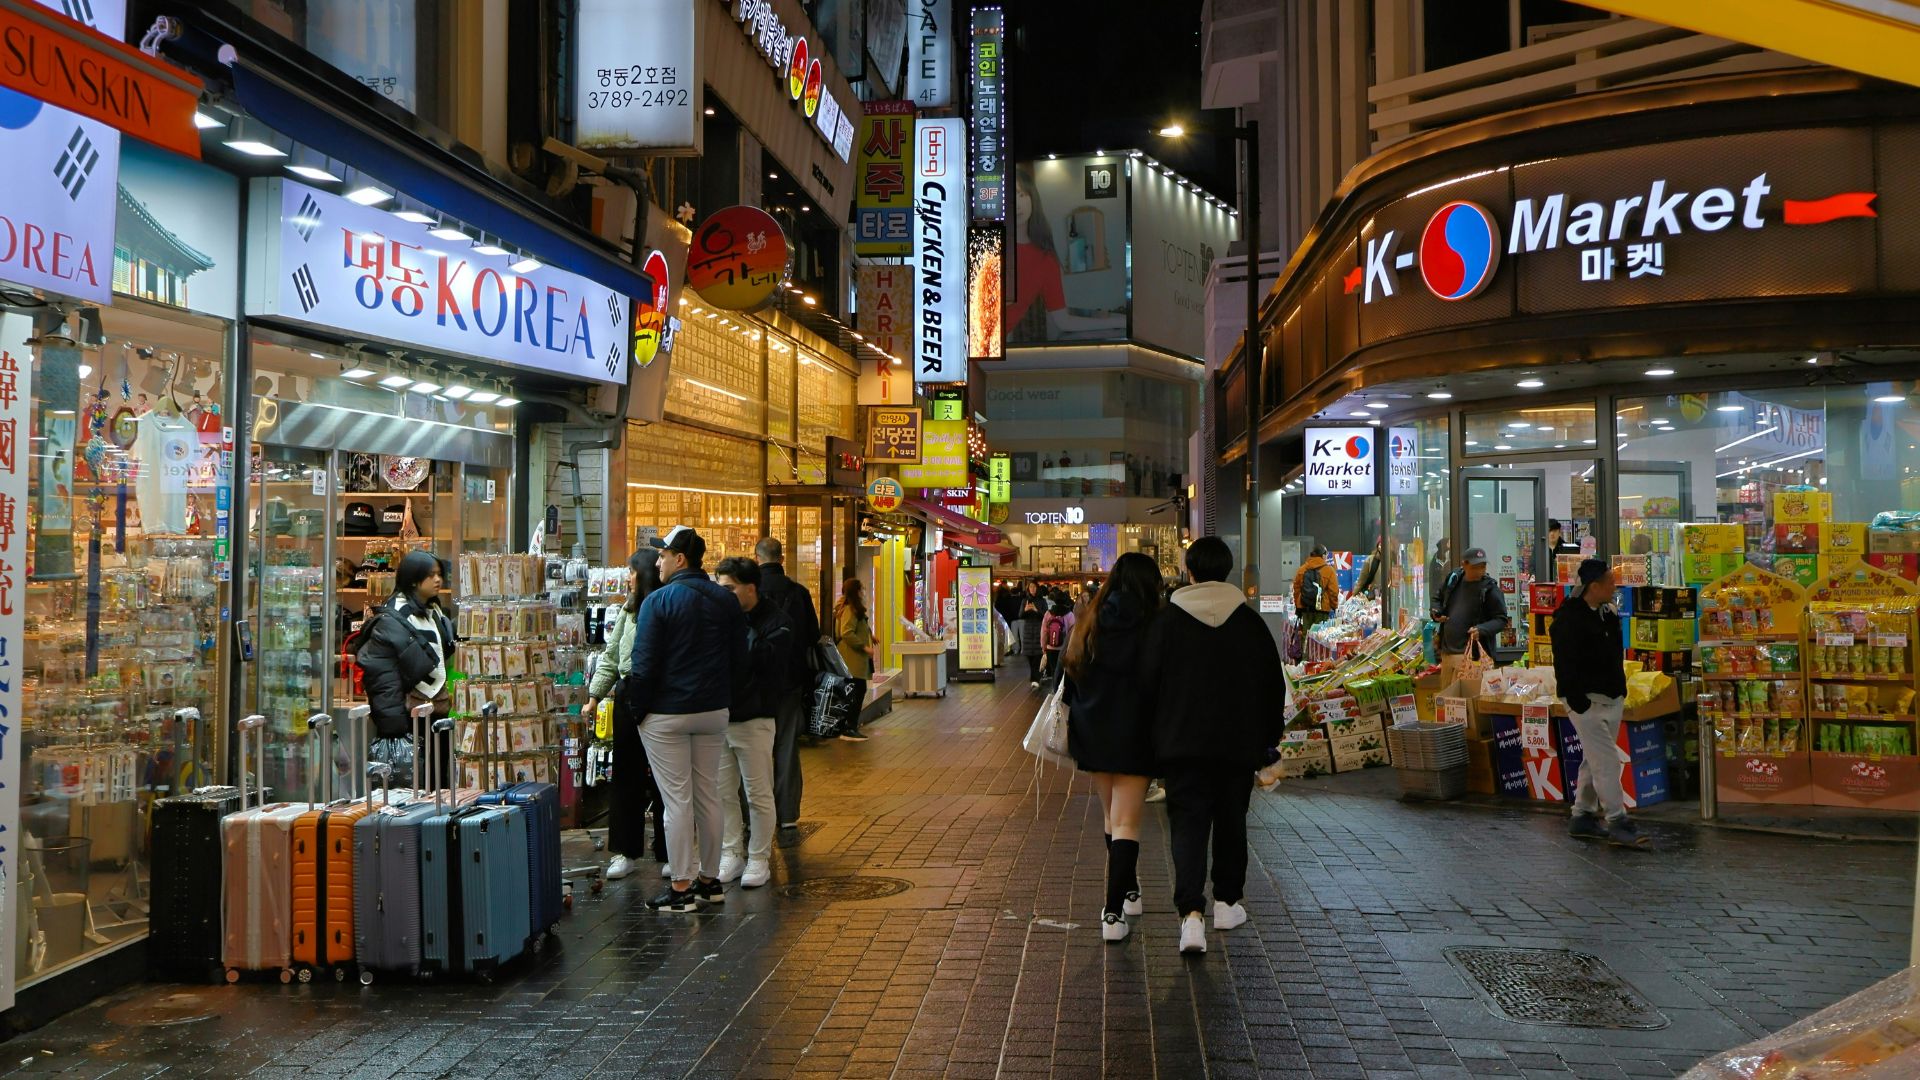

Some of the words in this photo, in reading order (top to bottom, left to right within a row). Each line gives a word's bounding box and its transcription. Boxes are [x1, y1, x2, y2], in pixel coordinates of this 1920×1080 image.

[4, 26, 150, 127] SUNSKIN
[597, 65, 676, 87] 명동2호점
[588, 89, 688, 109] 3789-2492
[919, 88, 937, 101] 4F
[978, 42, 998, 172] 코인노래연습장
[864, 119, 907, 203] 사주
[1090, 170, 1111, 189] 10
[979, 187, 998, 200] 3F
[1508, 172, 1771, 255] Market
[861, 212, 909, 240] 타로
[1363, 230, 1415, 304] K-
[1580, 242, 1666, 282] 마켓
[876, 270, 893, 399] HARUKI
[988, 388, 1023, 400] Good
[1028, 391, 1061, 400] wear
[873, 427, 916, 446] 전당포
[1312, 439, 1341, 457] K-
[1309, 461, 1372, 476] Market
[874, 484, 896, 496] 타로
[946, 489, 969, 498] SKIN
[1328, 479, 1352, 489] 마켓
[1334, 551, 1351, 571] K
[1527, 757, 1564, 800] K
